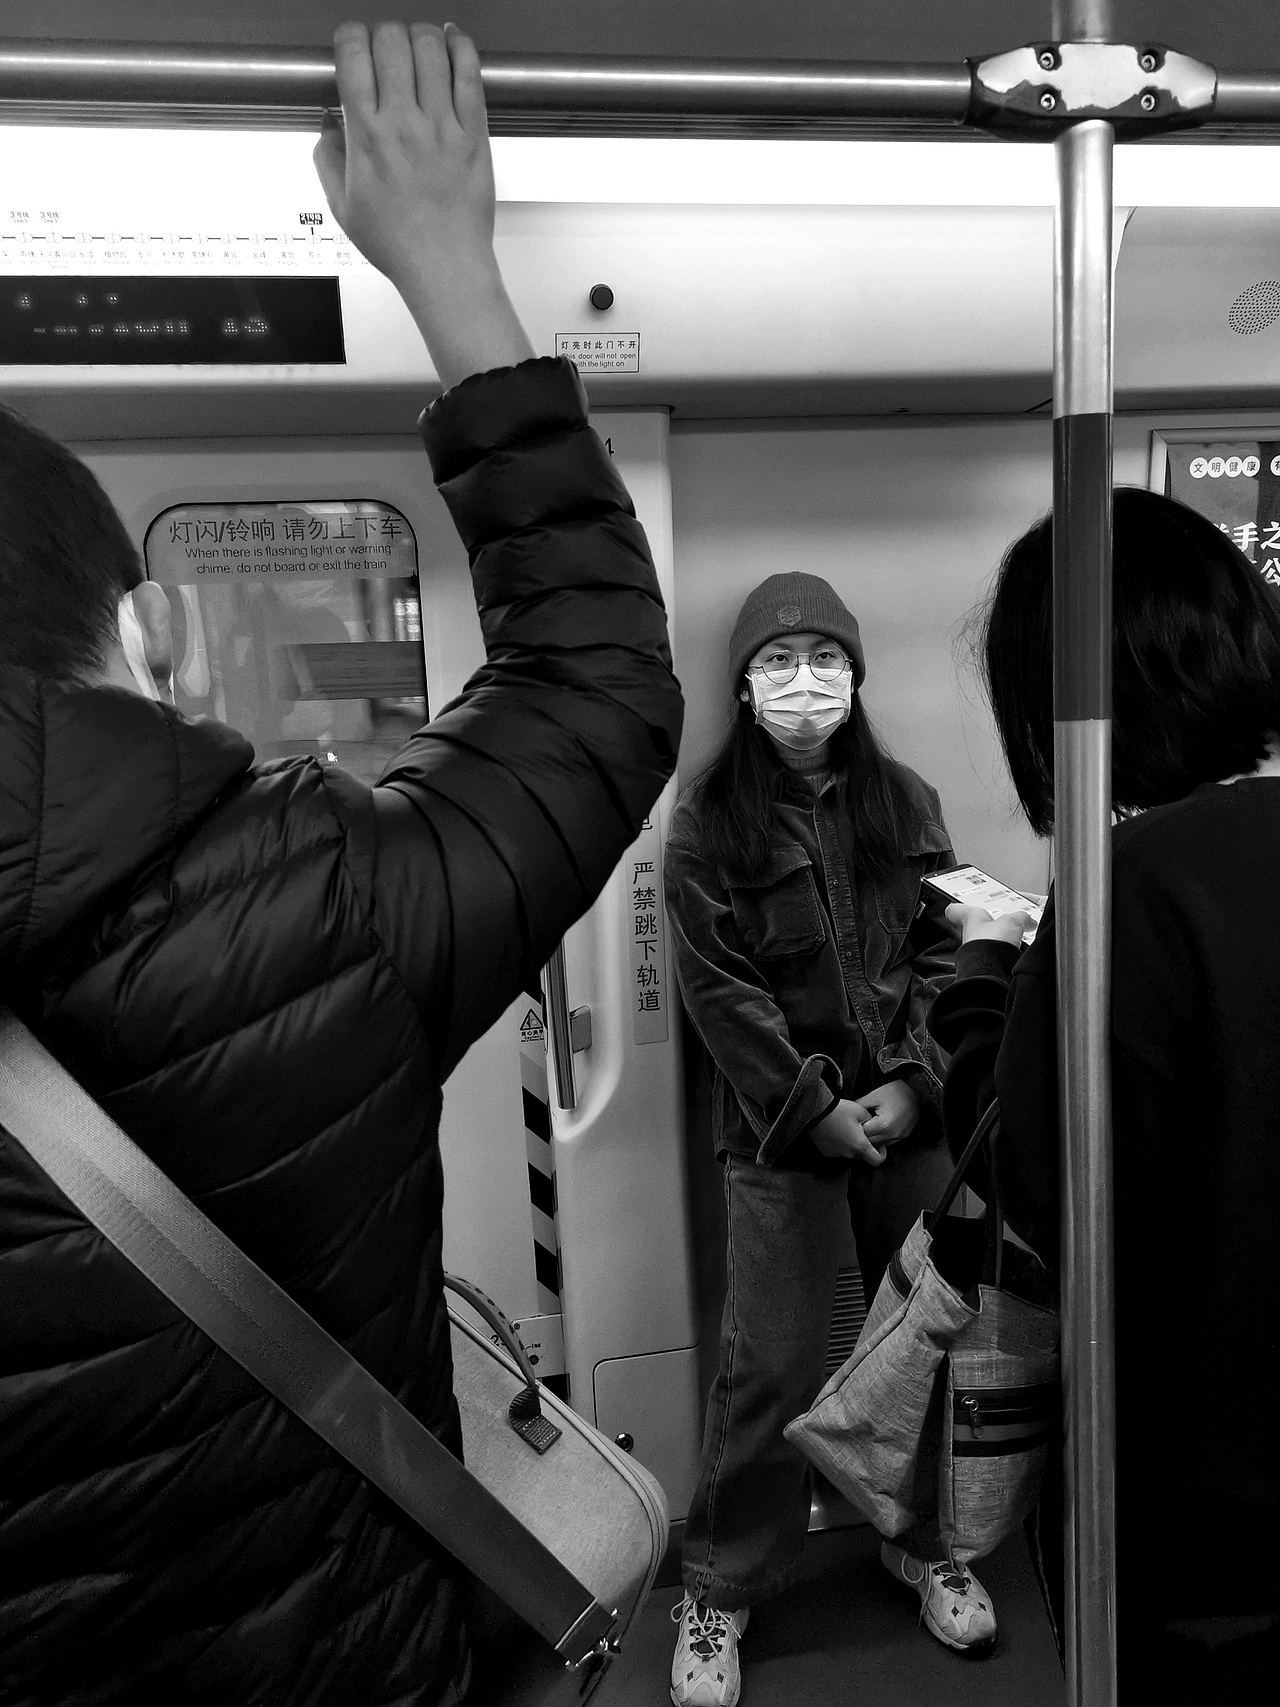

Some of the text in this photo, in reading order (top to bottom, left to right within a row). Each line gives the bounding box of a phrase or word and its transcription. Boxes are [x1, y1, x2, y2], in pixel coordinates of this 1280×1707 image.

[561, 340, 636, 350] 灯亮时此门不开
[578, 352, 593, 360] door
[594, 352, 606, 360] will
[600, 361, 614, 369] light
[169, 516, 403, 544] 灯闪/铃响 请勿上下车
[185, 544, 392, 559] When there is flashing light or warning
[237, 562, 251, 573] do
[254, 562, 271, 573] not
[274, 561, 306, 573] board
[308, 563, 320, 571] or
[322, 560, 341, 571] exit
[344, 560, 361, 570] the
[364, 559, 387, 570] train
[633, 861, 660, 1012] 严禁跳下轨道
